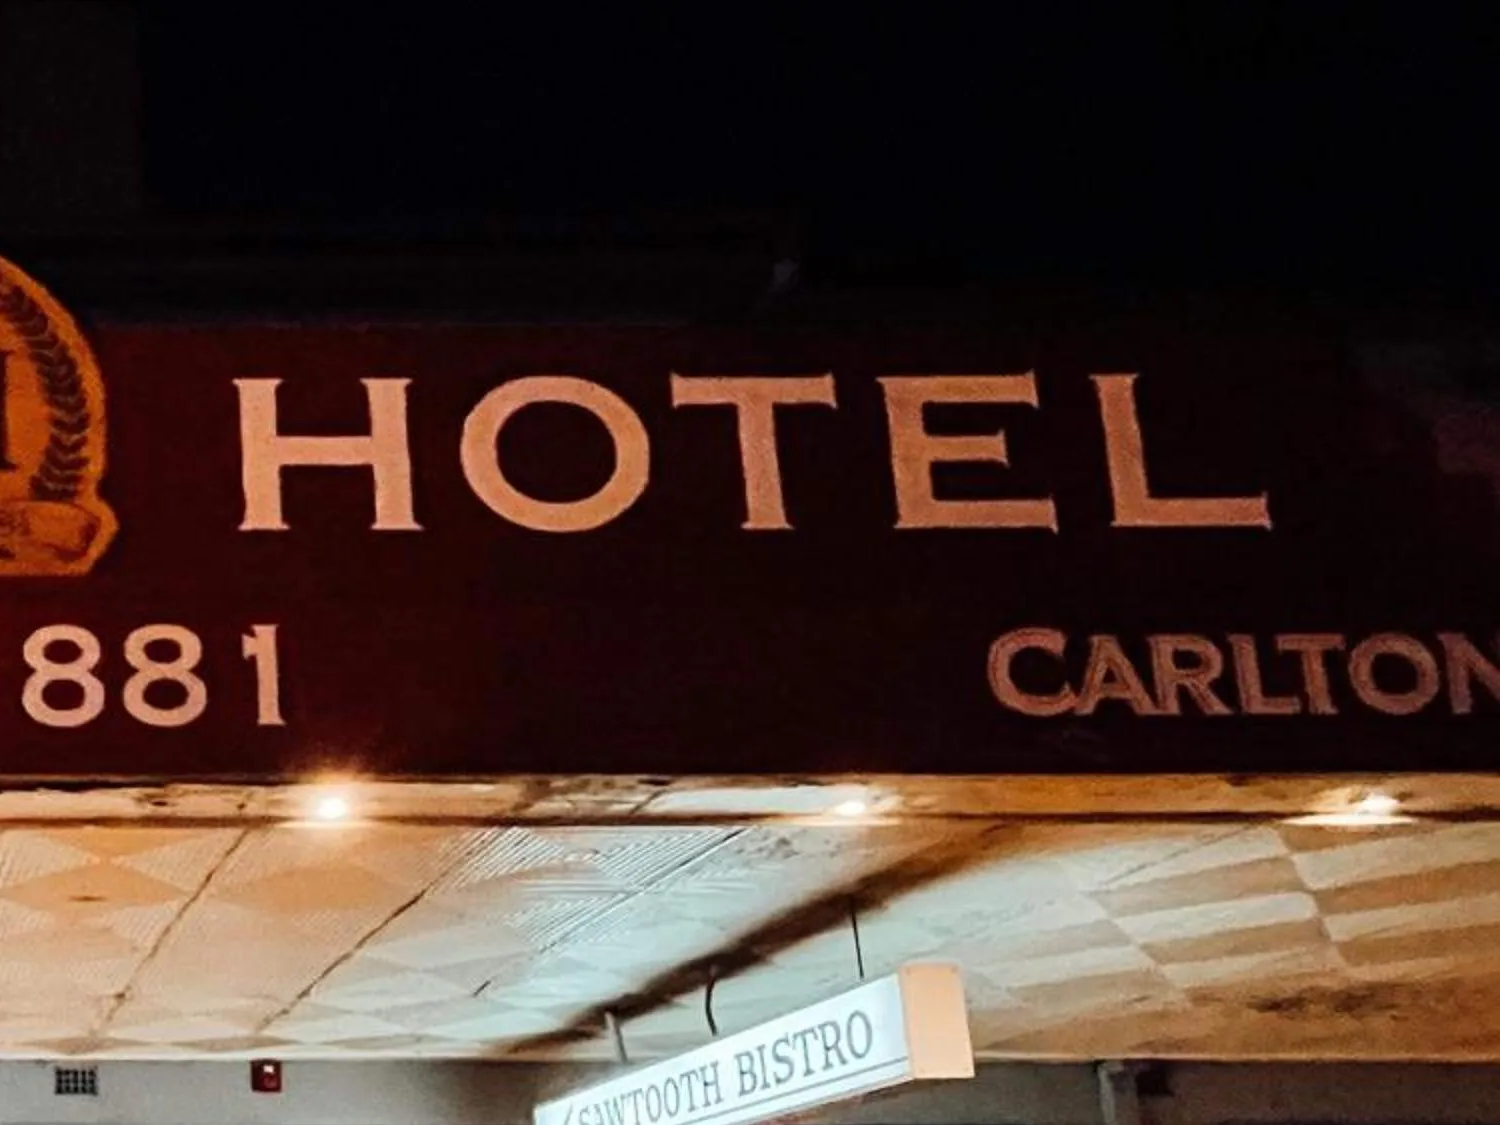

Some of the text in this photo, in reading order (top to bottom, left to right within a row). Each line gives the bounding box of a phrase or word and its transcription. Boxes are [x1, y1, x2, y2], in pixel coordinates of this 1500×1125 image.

[231, 371, 1272, 534] HOTEL
[987, 627, 1500, 717] CARLTON
[734, 1009, 873, 1098] BISTRO
